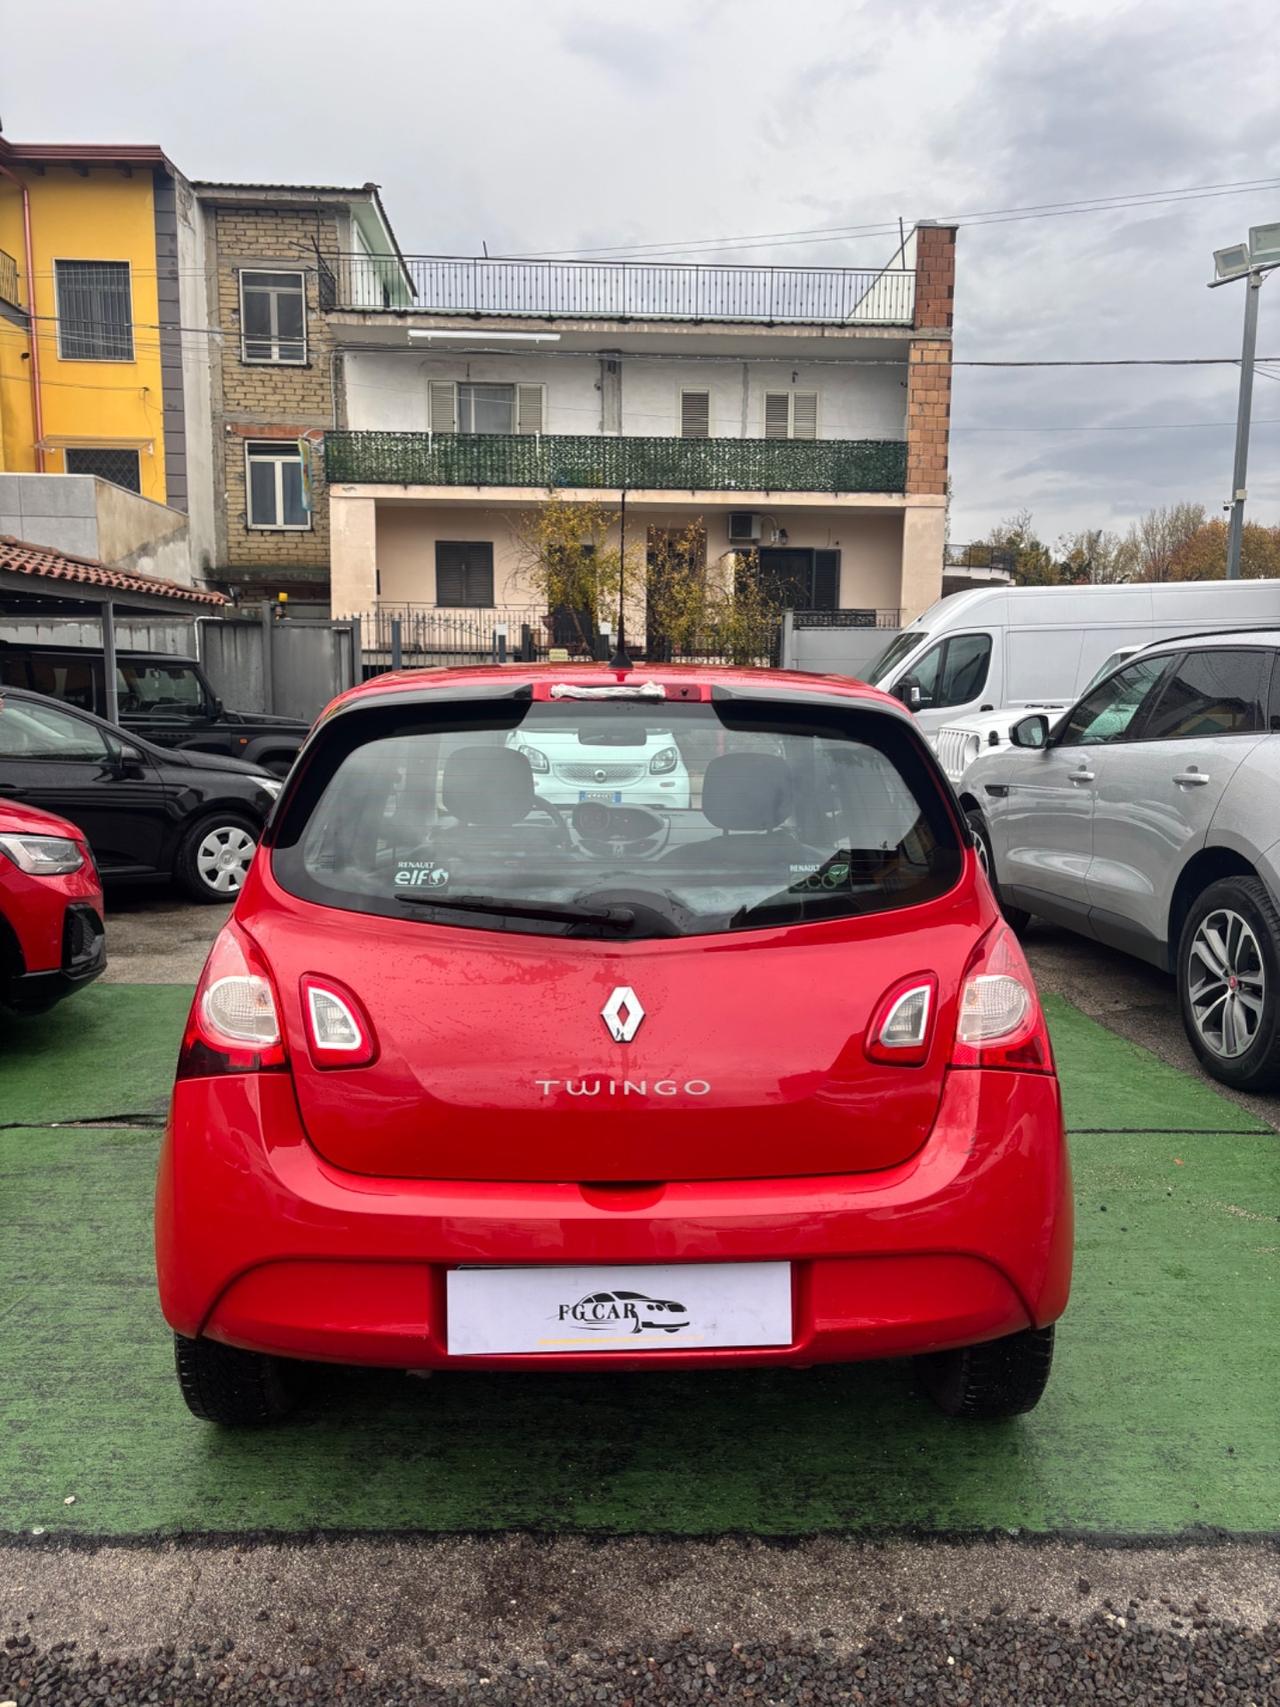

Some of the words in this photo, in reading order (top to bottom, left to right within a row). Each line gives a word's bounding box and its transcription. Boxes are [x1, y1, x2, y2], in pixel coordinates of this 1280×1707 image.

[394, 869, 430, 885] elf
[535, 1079, 711, 1096] TWINGO
[558, 1304, 585, 1321] FG
[592, 1303, 637, 1320] CAR
